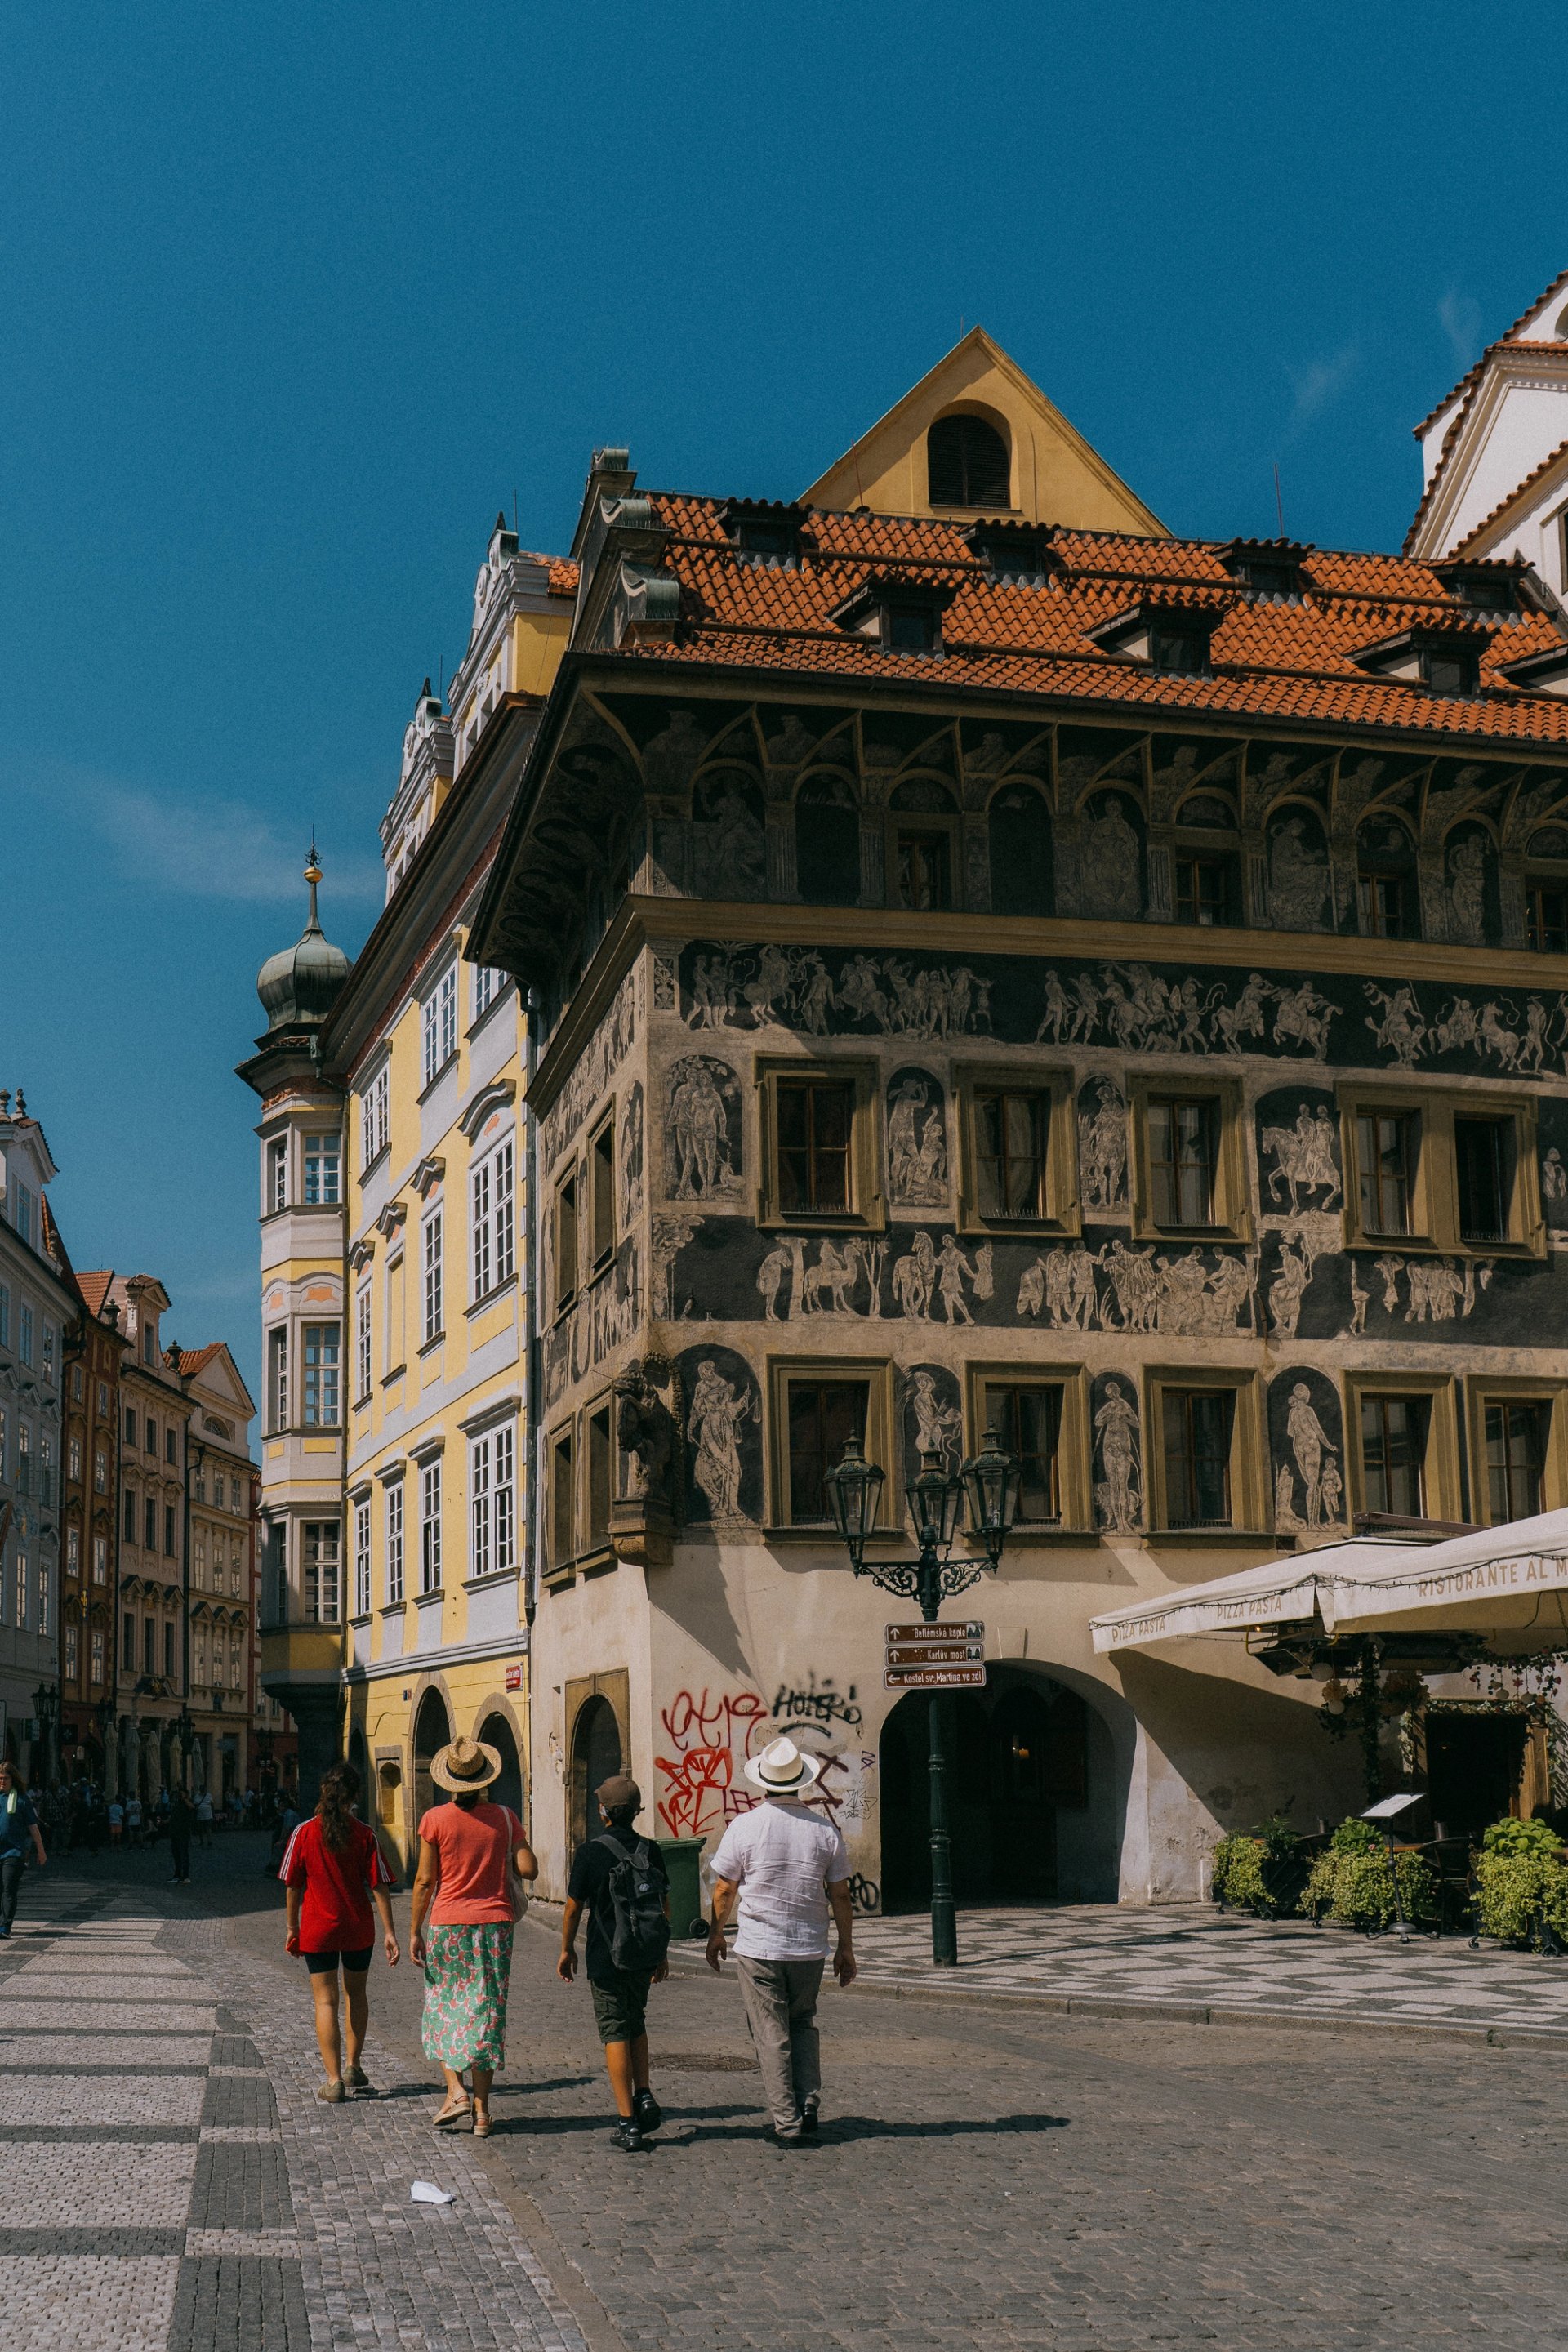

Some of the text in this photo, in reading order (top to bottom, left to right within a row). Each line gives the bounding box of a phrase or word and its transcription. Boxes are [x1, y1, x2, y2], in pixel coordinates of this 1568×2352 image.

[1419, 1563, 1518, 1597] RISTORANTE
[1526, 1560, 1548, 1581] AL
[1217, 1596, 1282, 1620] PIZZA PASTA
[915, 1627, 966, 1639] Betlémská kaple
[1111, 1618, 1165, 1642] PIZZA PASTA
[928, 1650, 965, 1659] Karlův most
[904, 1673, 924, 1683] Kostel
[936, 1672, 961, 1682] Martina
[962, 1673, 970, 1681] ve
[972, 1671, 981, 1681] zdi
